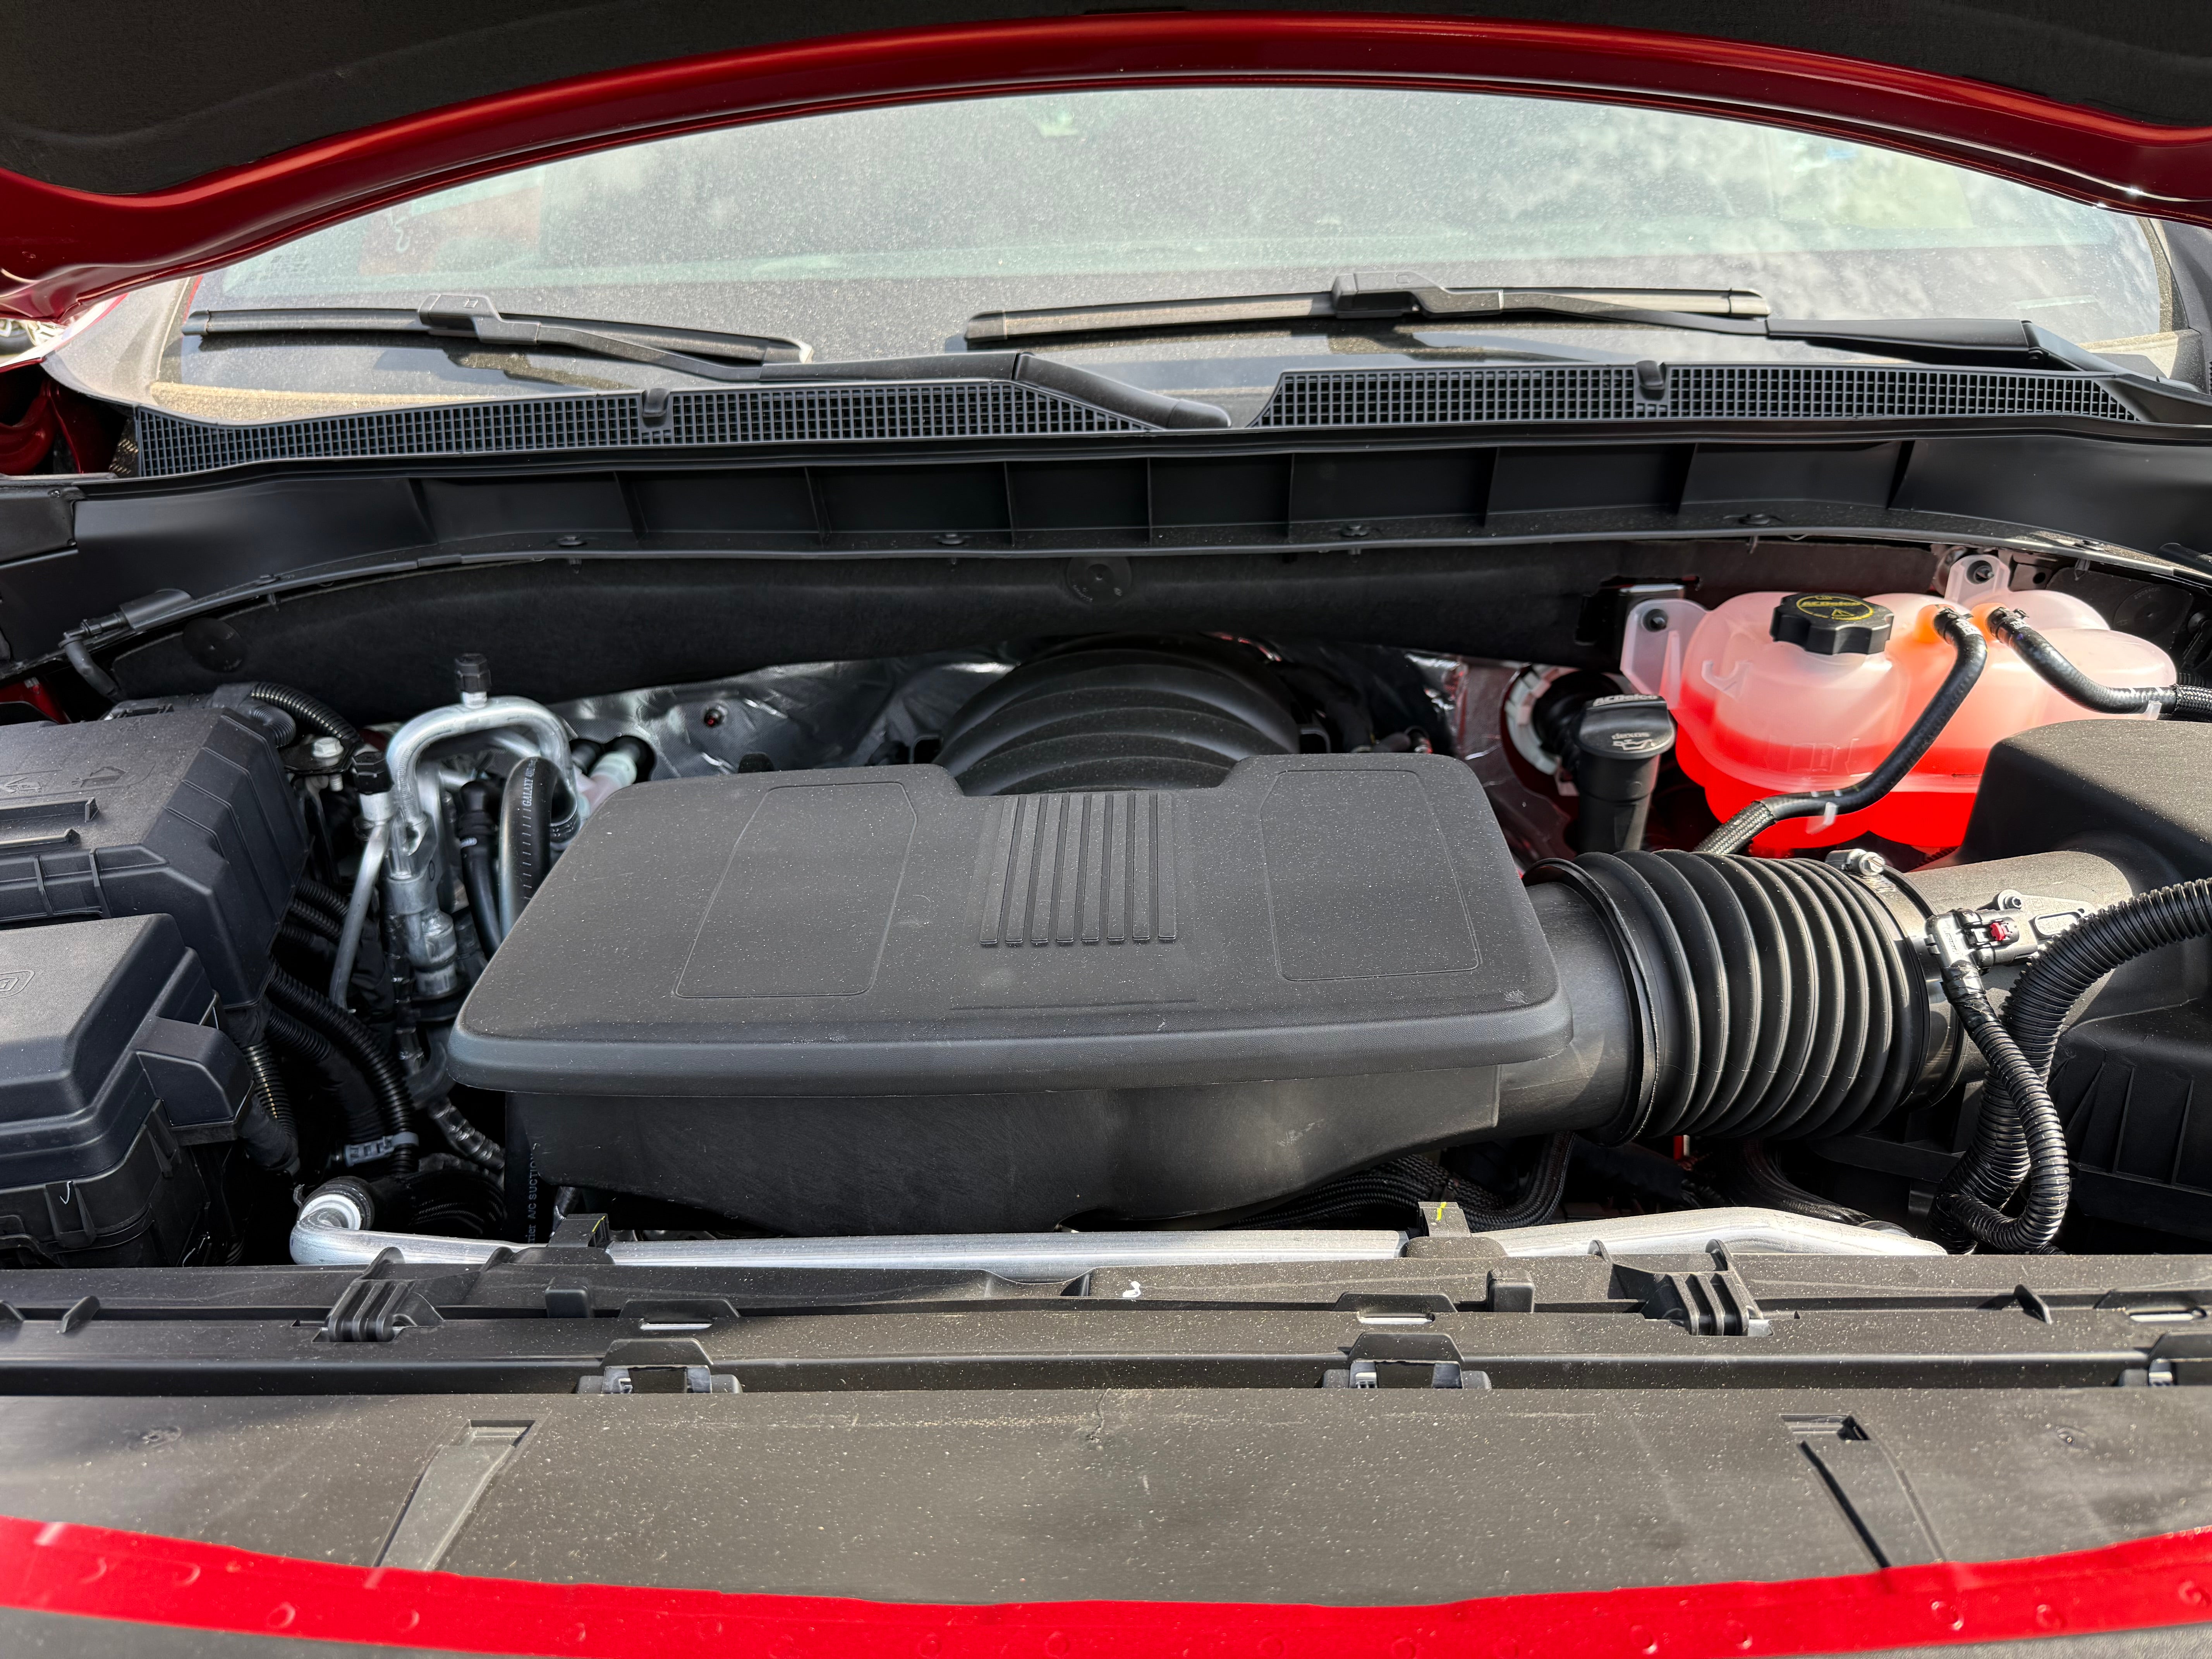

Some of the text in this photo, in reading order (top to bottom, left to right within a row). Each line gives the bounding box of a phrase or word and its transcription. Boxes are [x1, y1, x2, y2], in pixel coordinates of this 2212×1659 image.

[1592, 693, 1658, 706] ACDelco
[1611, 732, 1650, 740] dexos
[522, 778, 533, 807] GALAXY
[529, 1153, 538, 1200] SUCTIO
[528, 1203, 536, 1219] A/C
